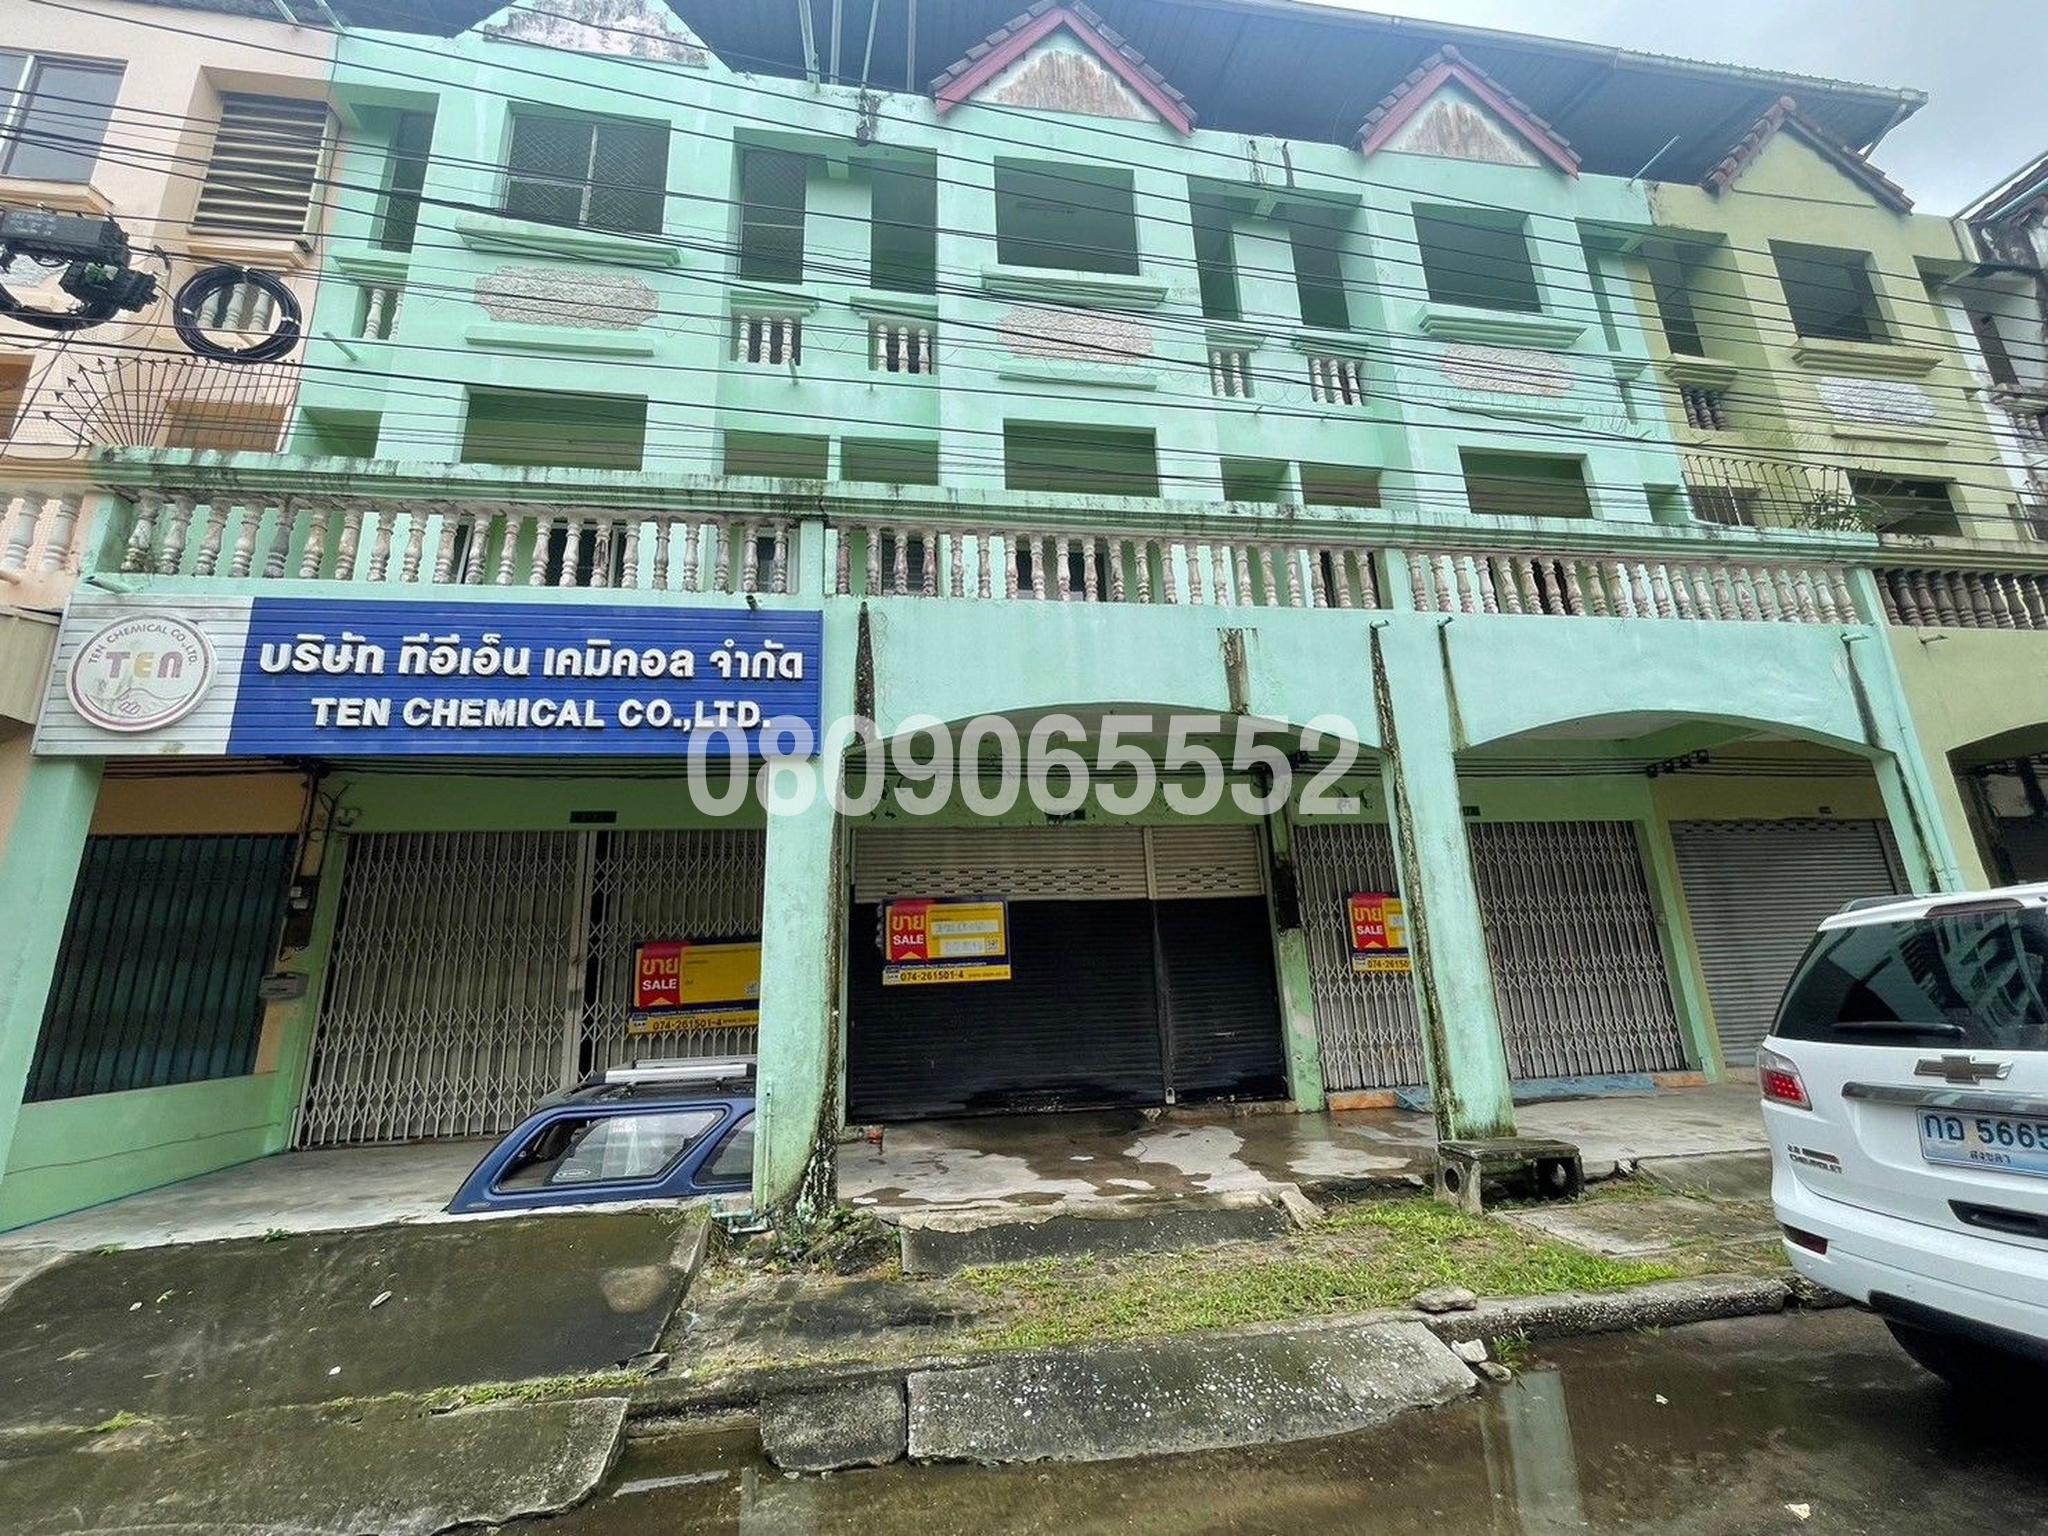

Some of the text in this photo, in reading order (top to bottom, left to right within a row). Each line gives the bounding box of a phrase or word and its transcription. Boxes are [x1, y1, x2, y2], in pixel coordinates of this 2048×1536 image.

[88, 643, 106, 665] TEN
[107, 623, 168, 644] CHEMICAL
[105, 651, 183, 678] TEN
[259, 631, 804, 679] บริษัท ทีอีเอ็น เคมิคอล จำกัด
[311, 697, 391, 727] TEN
[402, 697, 606, 727] CHEMICAL
[891, 914, 925, 931] ขาย
[1353, 907, 1382, 923] ขาย
[892, 933, 925, 946] SALE
[1356, 925, 1384, 936] SALE
[642, 957, 679, 976] ขาย
[642, 978, 677, 991] SALE
[1975, 1118, 2048, 1150] 5665
